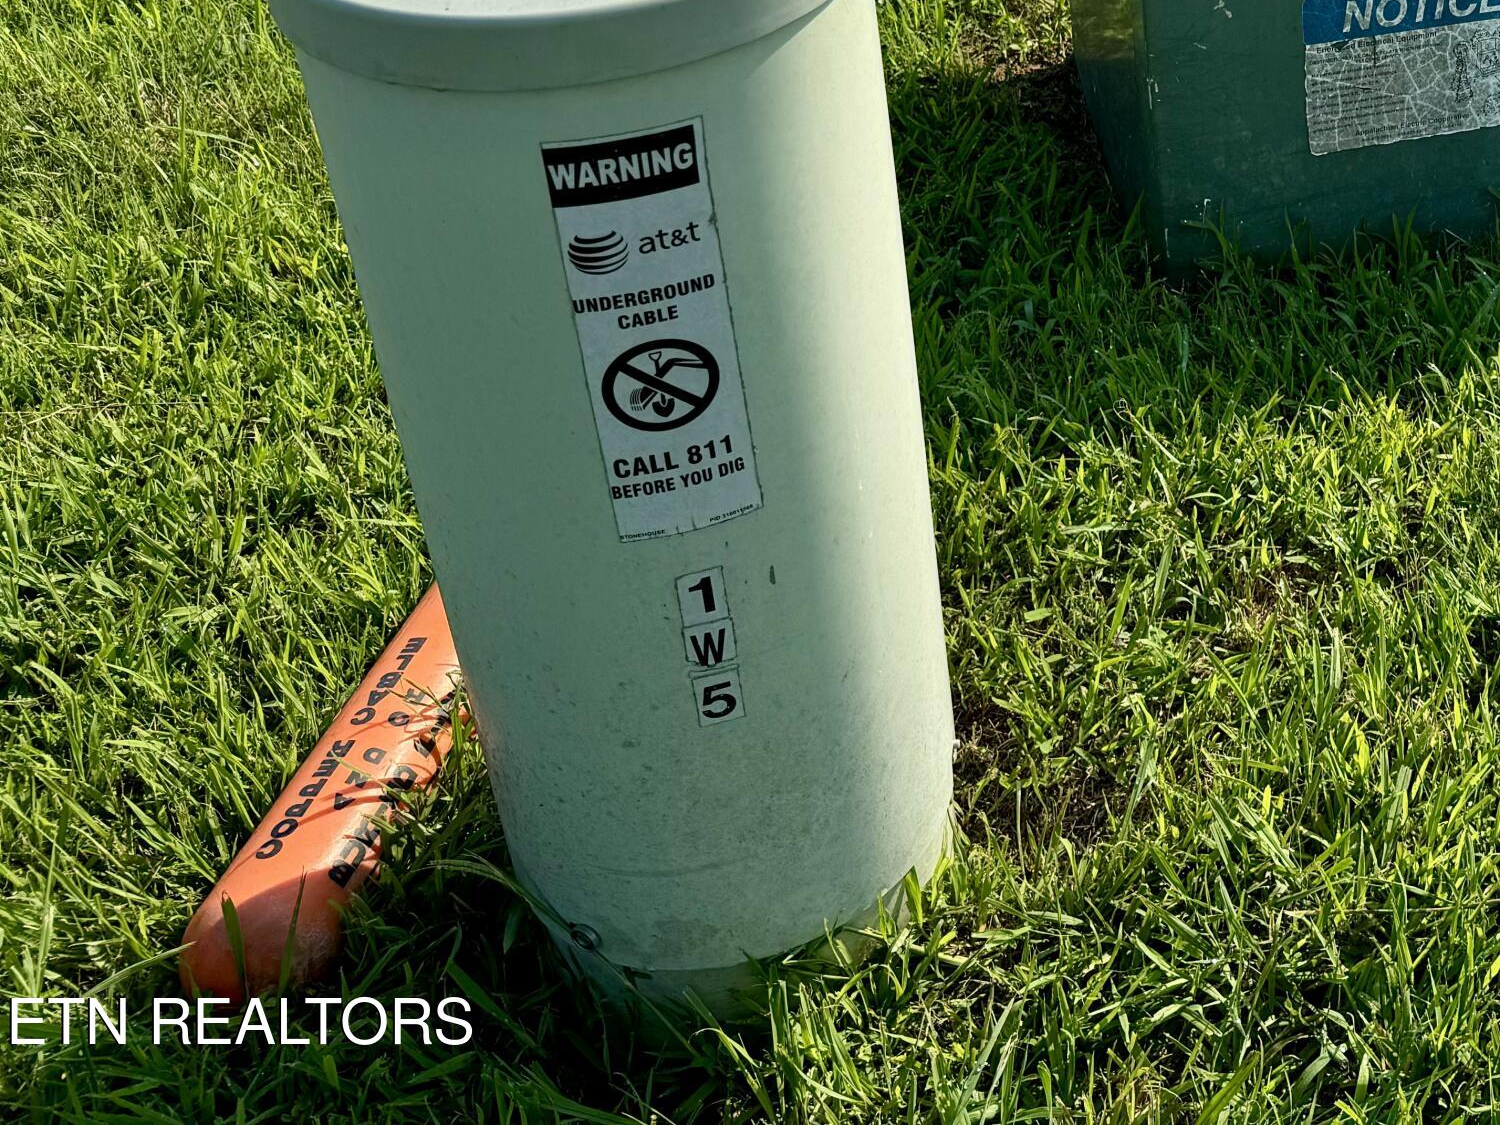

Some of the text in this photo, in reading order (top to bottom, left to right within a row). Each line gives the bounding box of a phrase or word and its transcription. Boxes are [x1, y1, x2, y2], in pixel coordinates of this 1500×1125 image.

[547, 142, 694, 190] WARNING
[638, 221, 701, 254] at&t
[572, 274, 716, 314] UNDERGROUND
[617, 305, 679, 330] CABLE
[613, 434, 734, 479] CALL 811
[611, 457, 746, 500] BEFORE YOU DIG
[688, 576, 716, 613] 1
[690, 628, 726, 667] W
[702, 681, 737, 719] 5
[255, 637, 428, 860] COPPER CABLE
